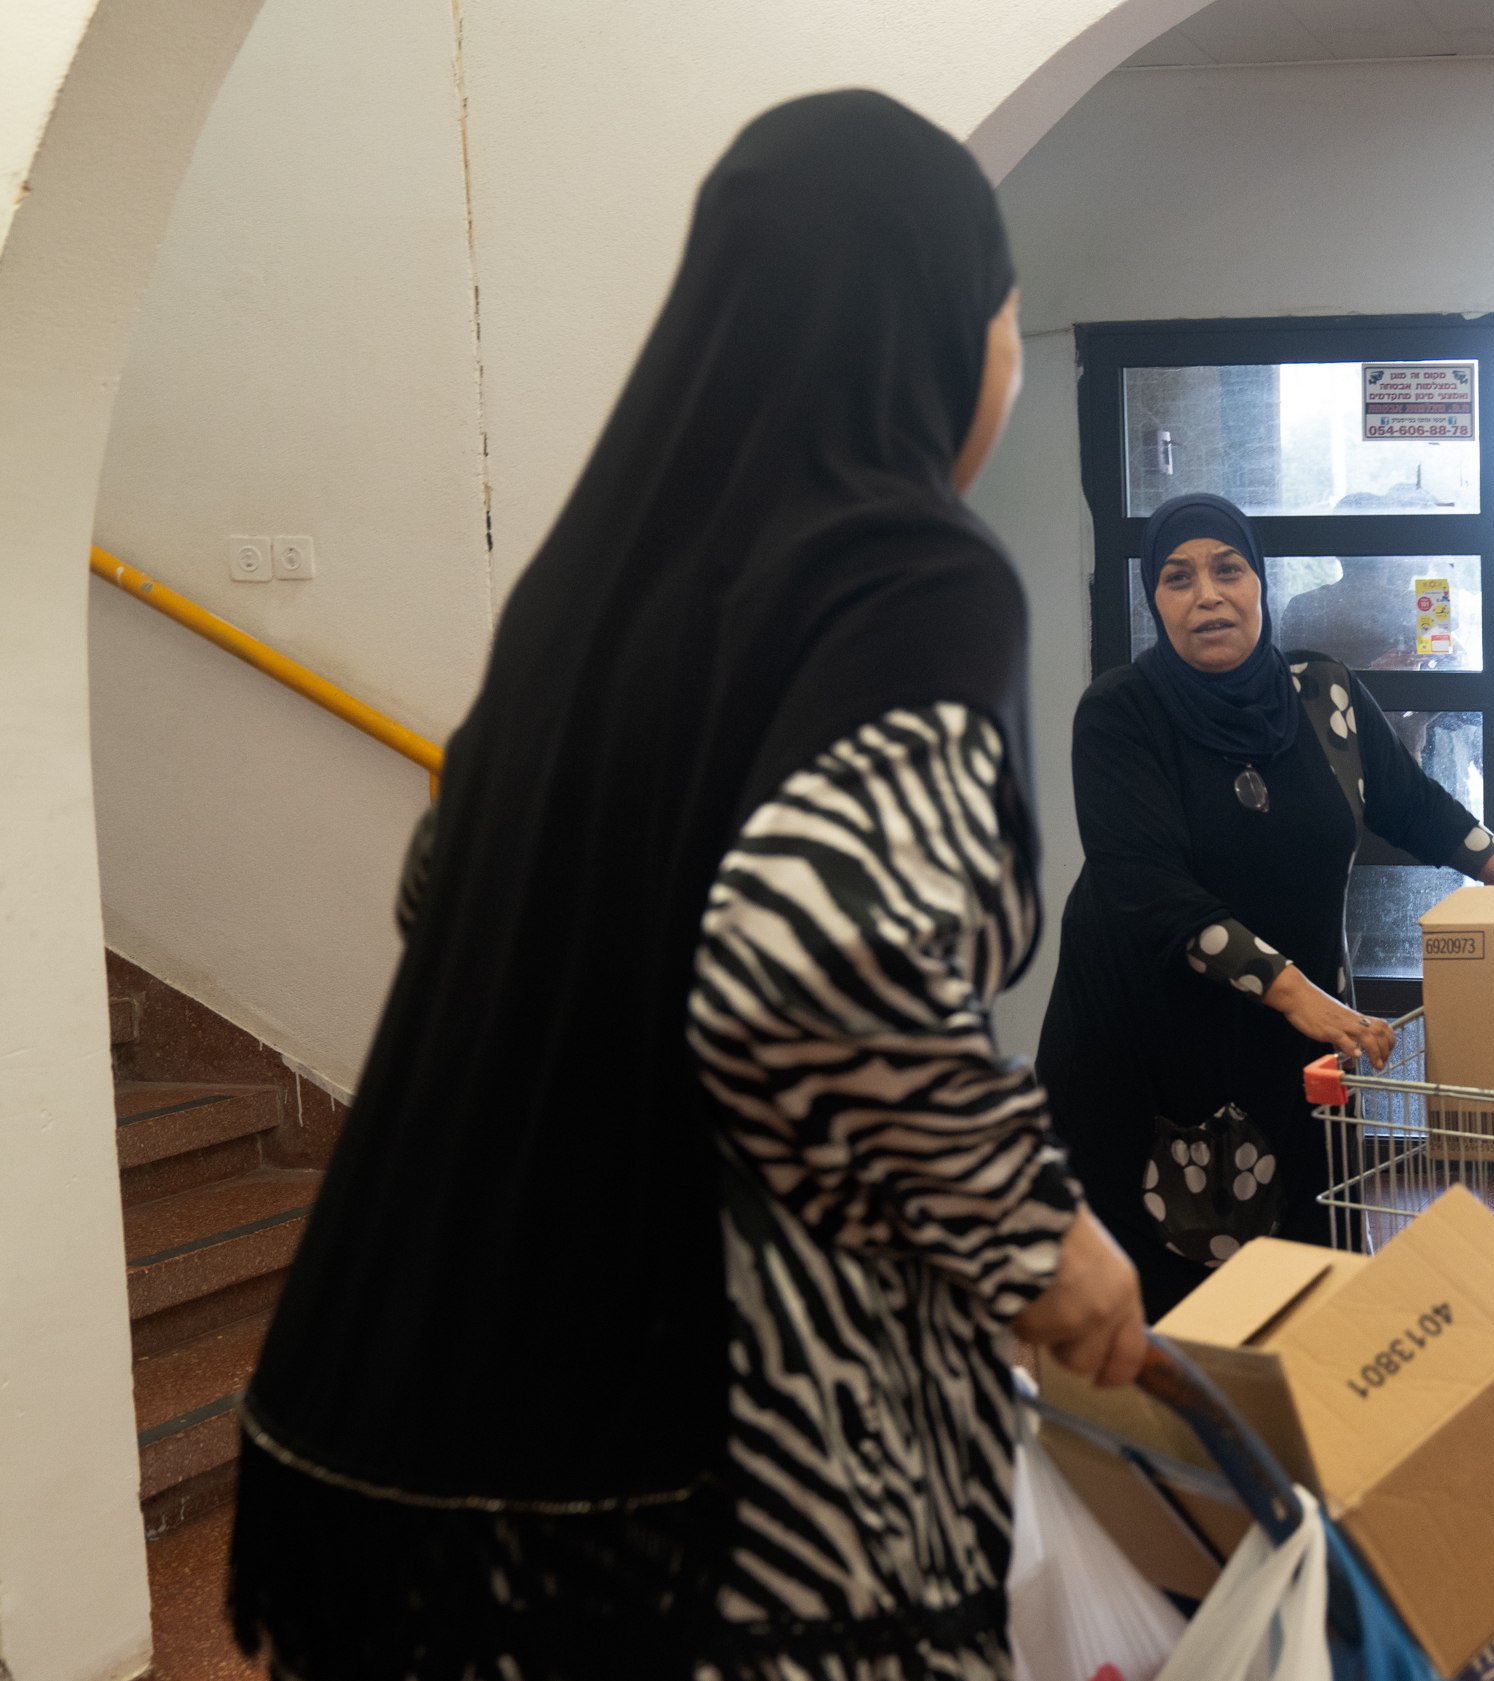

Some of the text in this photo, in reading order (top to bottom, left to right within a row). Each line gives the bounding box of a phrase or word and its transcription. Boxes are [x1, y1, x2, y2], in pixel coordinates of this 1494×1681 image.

[1390, 372, 1406, 380] מוגן
[1423, 372, 1446, 380] מקום
[1415, 382, 1457, 390] במצלמות
[1369, 393, 1411, 401] מתקדמים
[1415, 393, 1434, 401] מיגון
[1368, 425, 1469, 436] 054-606-88-78
[1425, 937, 1476, 954] 6920973
[1347, 1302, 1453, 1399] 4013801
